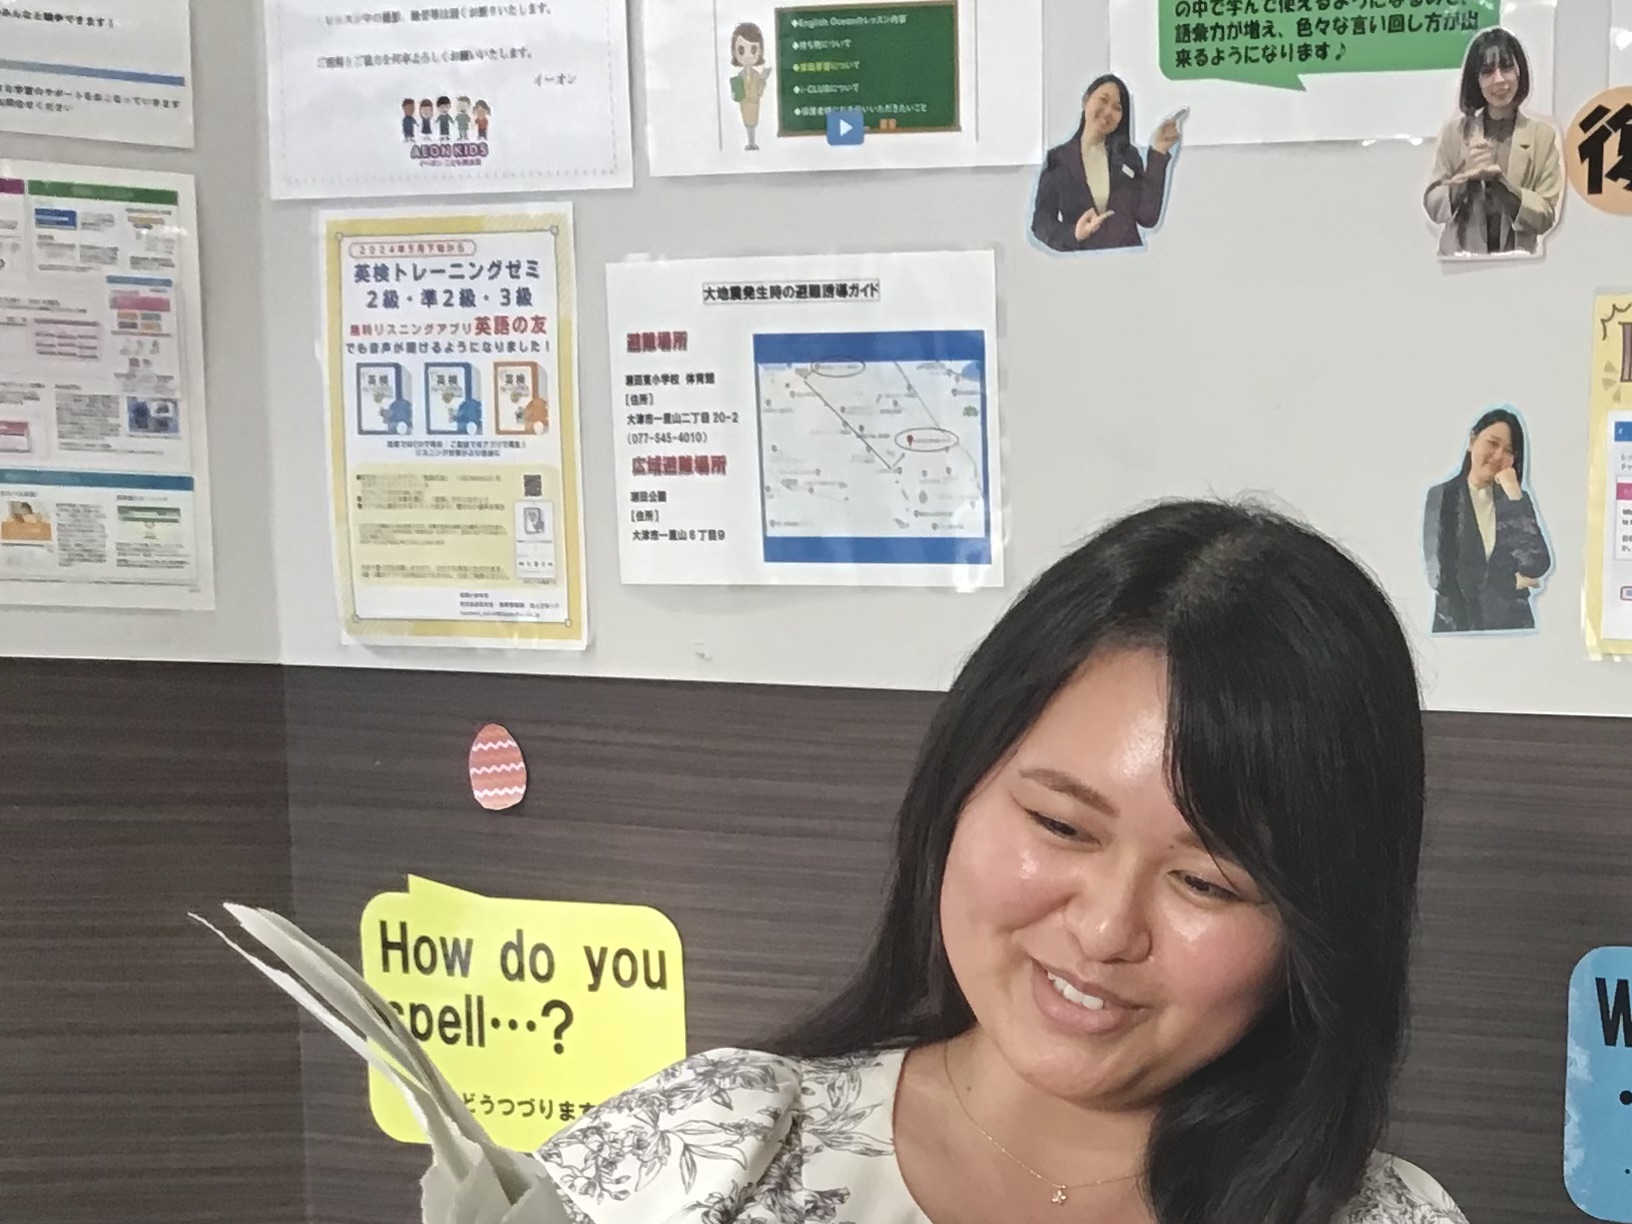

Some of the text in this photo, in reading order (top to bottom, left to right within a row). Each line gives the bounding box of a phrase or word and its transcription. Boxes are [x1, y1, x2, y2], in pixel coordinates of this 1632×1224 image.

[411, 142, 489, 160] AEON KIDS
[354, 259, 541, 284] 英検トレーニングゼミ
[379, 919, 667, 992] How do you
